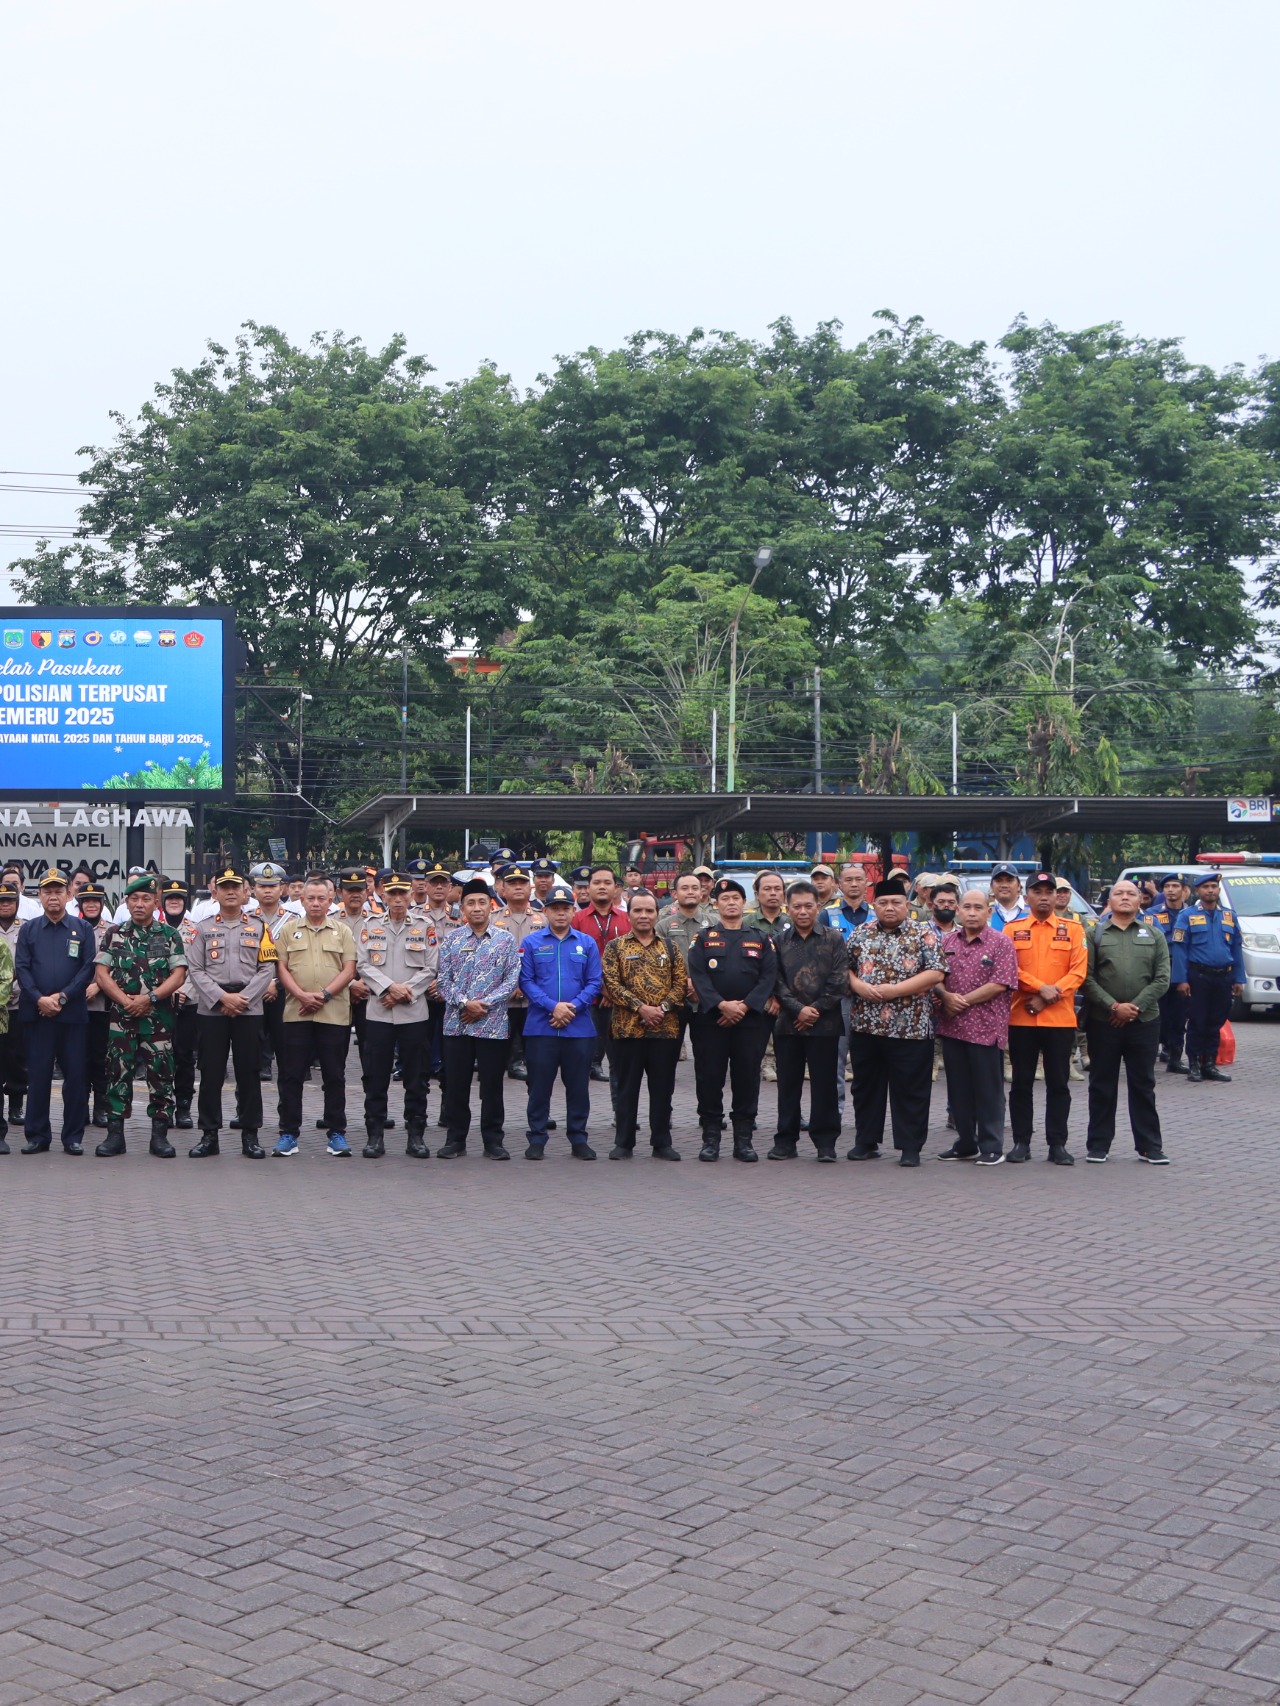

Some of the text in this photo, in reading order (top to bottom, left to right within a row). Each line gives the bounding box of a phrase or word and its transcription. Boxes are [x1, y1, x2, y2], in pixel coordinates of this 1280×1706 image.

[37, 658, 124, 676] Pasukan
[79, 684, 168, 702] TERPUSAT
[64, 707, 115, 725] 2025
[31, 733, 61, 744] NATAL
[63, 733, 90, 744] 2025
[92, 733, 113, 744] DAN
[115, 733, 146, 744] TAHUN
[148, 733, 175, 744] BARU
[177, 733, 204, 744] 2026
[1249, 800, 1268, 811] BRI
[53, 807, 194, 828] LAGHAWA
[62, 832, 111, 848] APEL
[1228, 876, 1280, 886] POLRES PA
[240, 931, 259, 939] POLRI
[405, 936, 425, 944] POLRI
